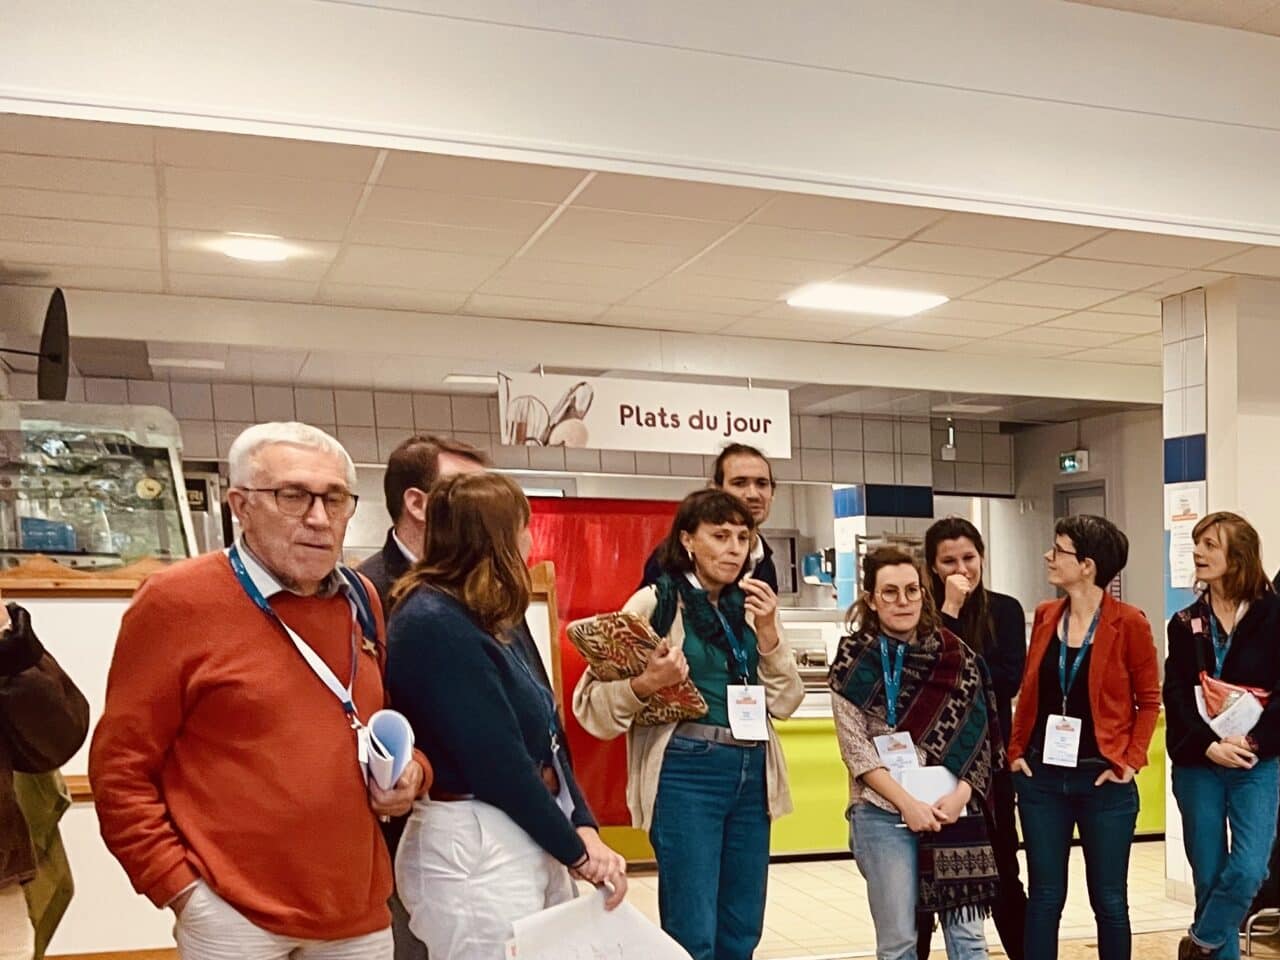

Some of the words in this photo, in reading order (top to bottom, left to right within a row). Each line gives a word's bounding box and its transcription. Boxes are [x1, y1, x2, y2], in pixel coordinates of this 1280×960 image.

[619, 404, 681, 429] Plats
[688, 410, 718, 431] du
[723, 411, 773, 437] jour
